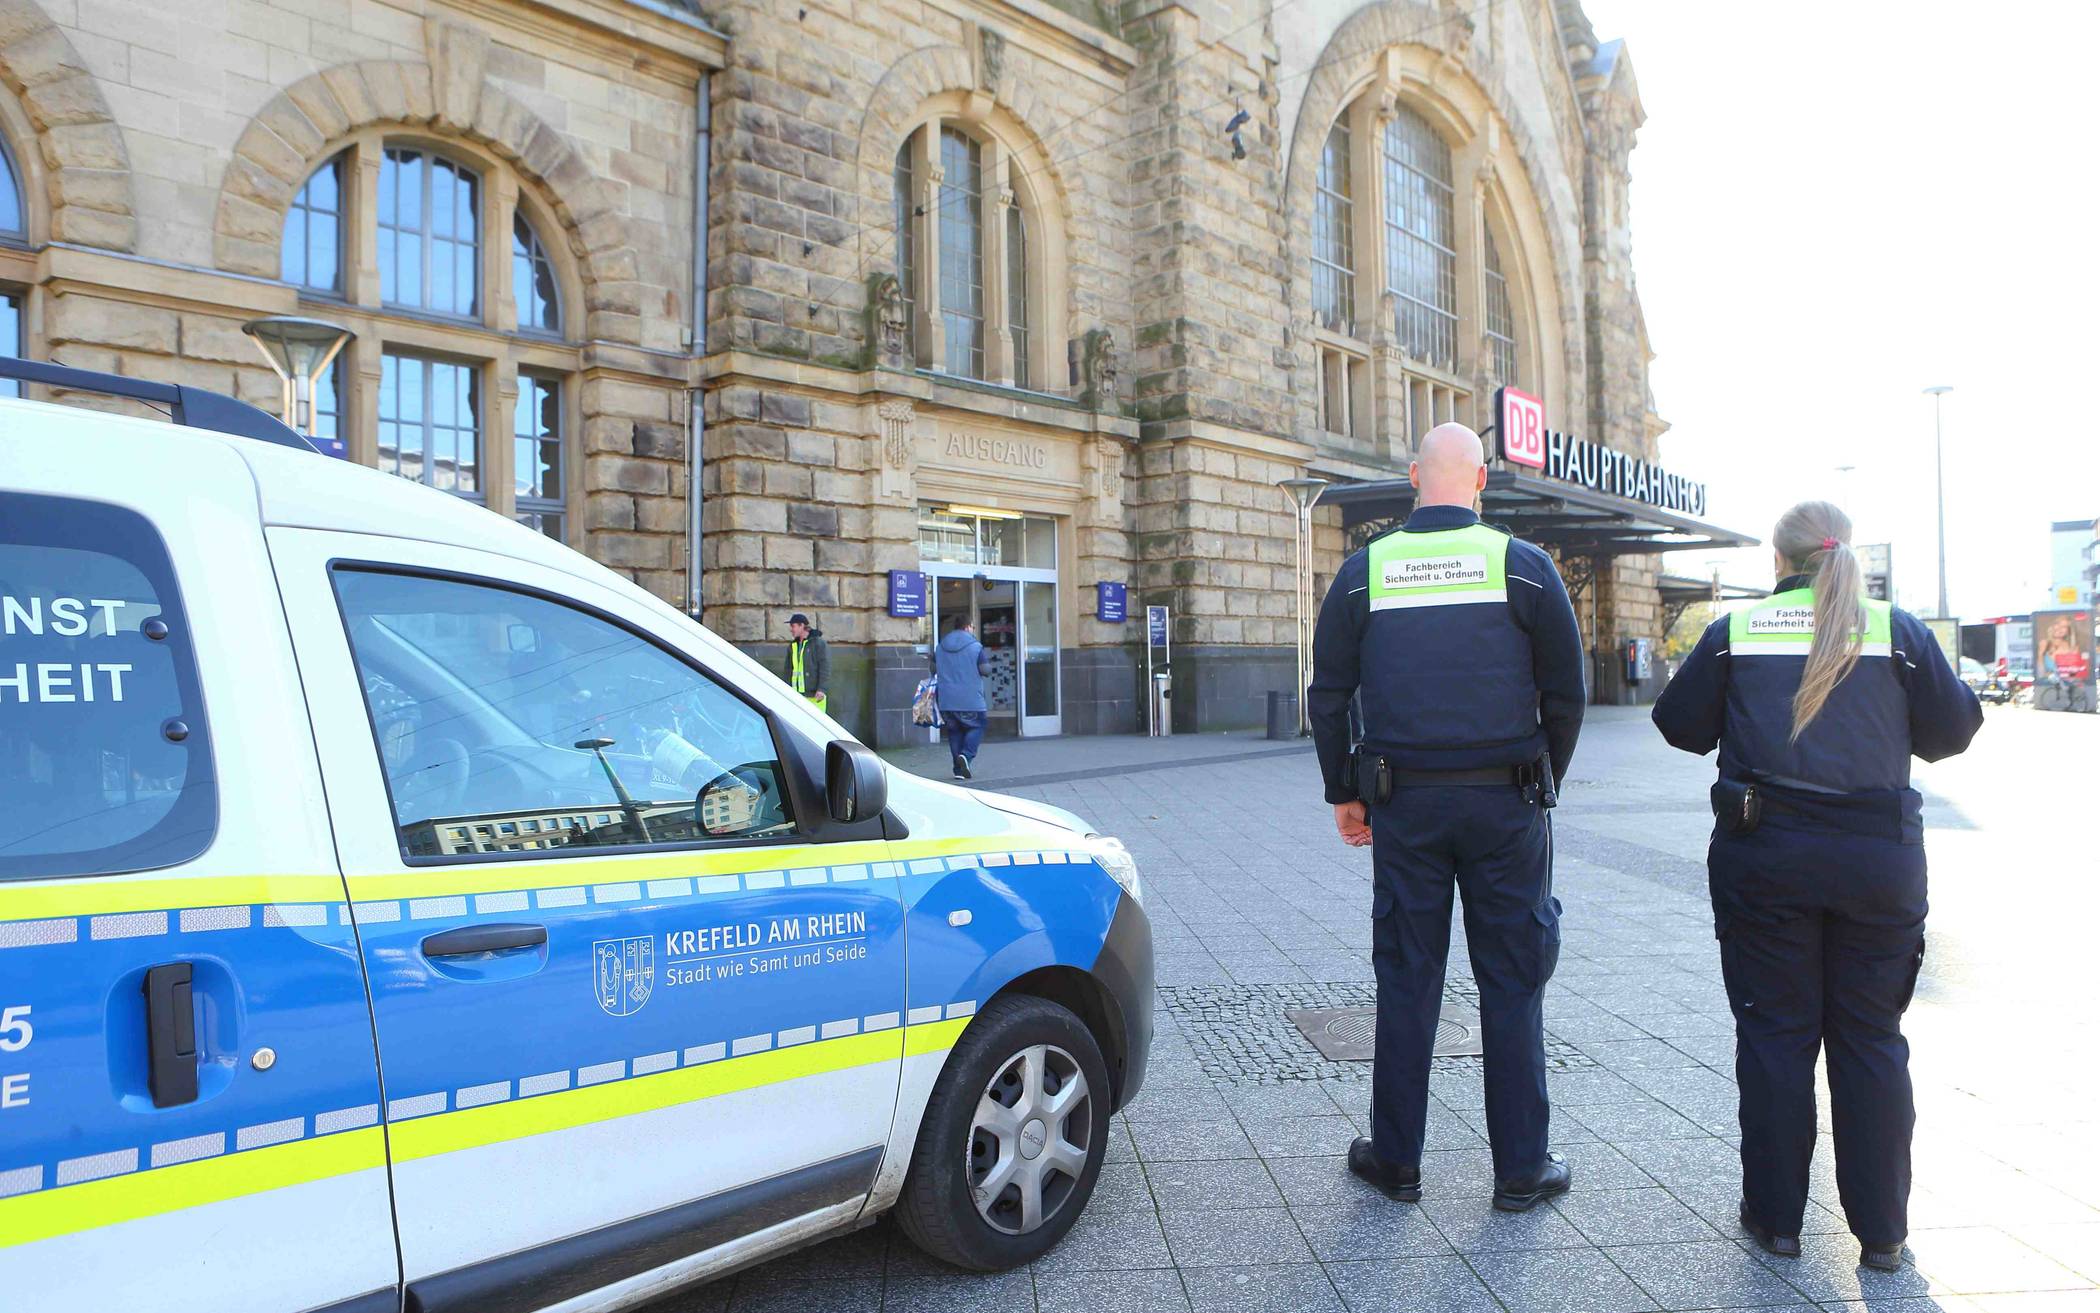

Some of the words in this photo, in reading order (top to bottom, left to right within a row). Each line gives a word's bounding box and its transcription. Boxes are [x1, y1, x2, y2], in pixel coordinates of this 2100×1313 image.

[1509, 400, 1539, 455] DB
[946, 432, 1046, 468] AUSGANG
[1546, 428, 1706, 516] HAUPTBAHNHO
[1385, 573, 1431, 584] Sicherheit
[1433, 573, 1442, 581] u.
[1445, 569, 1484, 579] Ordnung
[1405, 560, 1462, 573] Fachbereich
[1751, 619, 1805, 629] Sicherheit
[1776, 610, 1814, 618] Fachbe
[666, 923, 761, 957] KREFELD
[768, 918, 800, 943] AM
[808, 911, 866, 938] RHEIN
[666, 964, 711, 987] Stadt
[716, 960, 744, 980] wie
[749, 952, 788, 975] Samt
[794, 949, 821, 969] und
[826, 943, 866, 963] Seide
[0, 1005, 34, 1053] 5
[1, 1073, 31, 1109] E
[1023, 1130, 1044, 1148] DACIA
